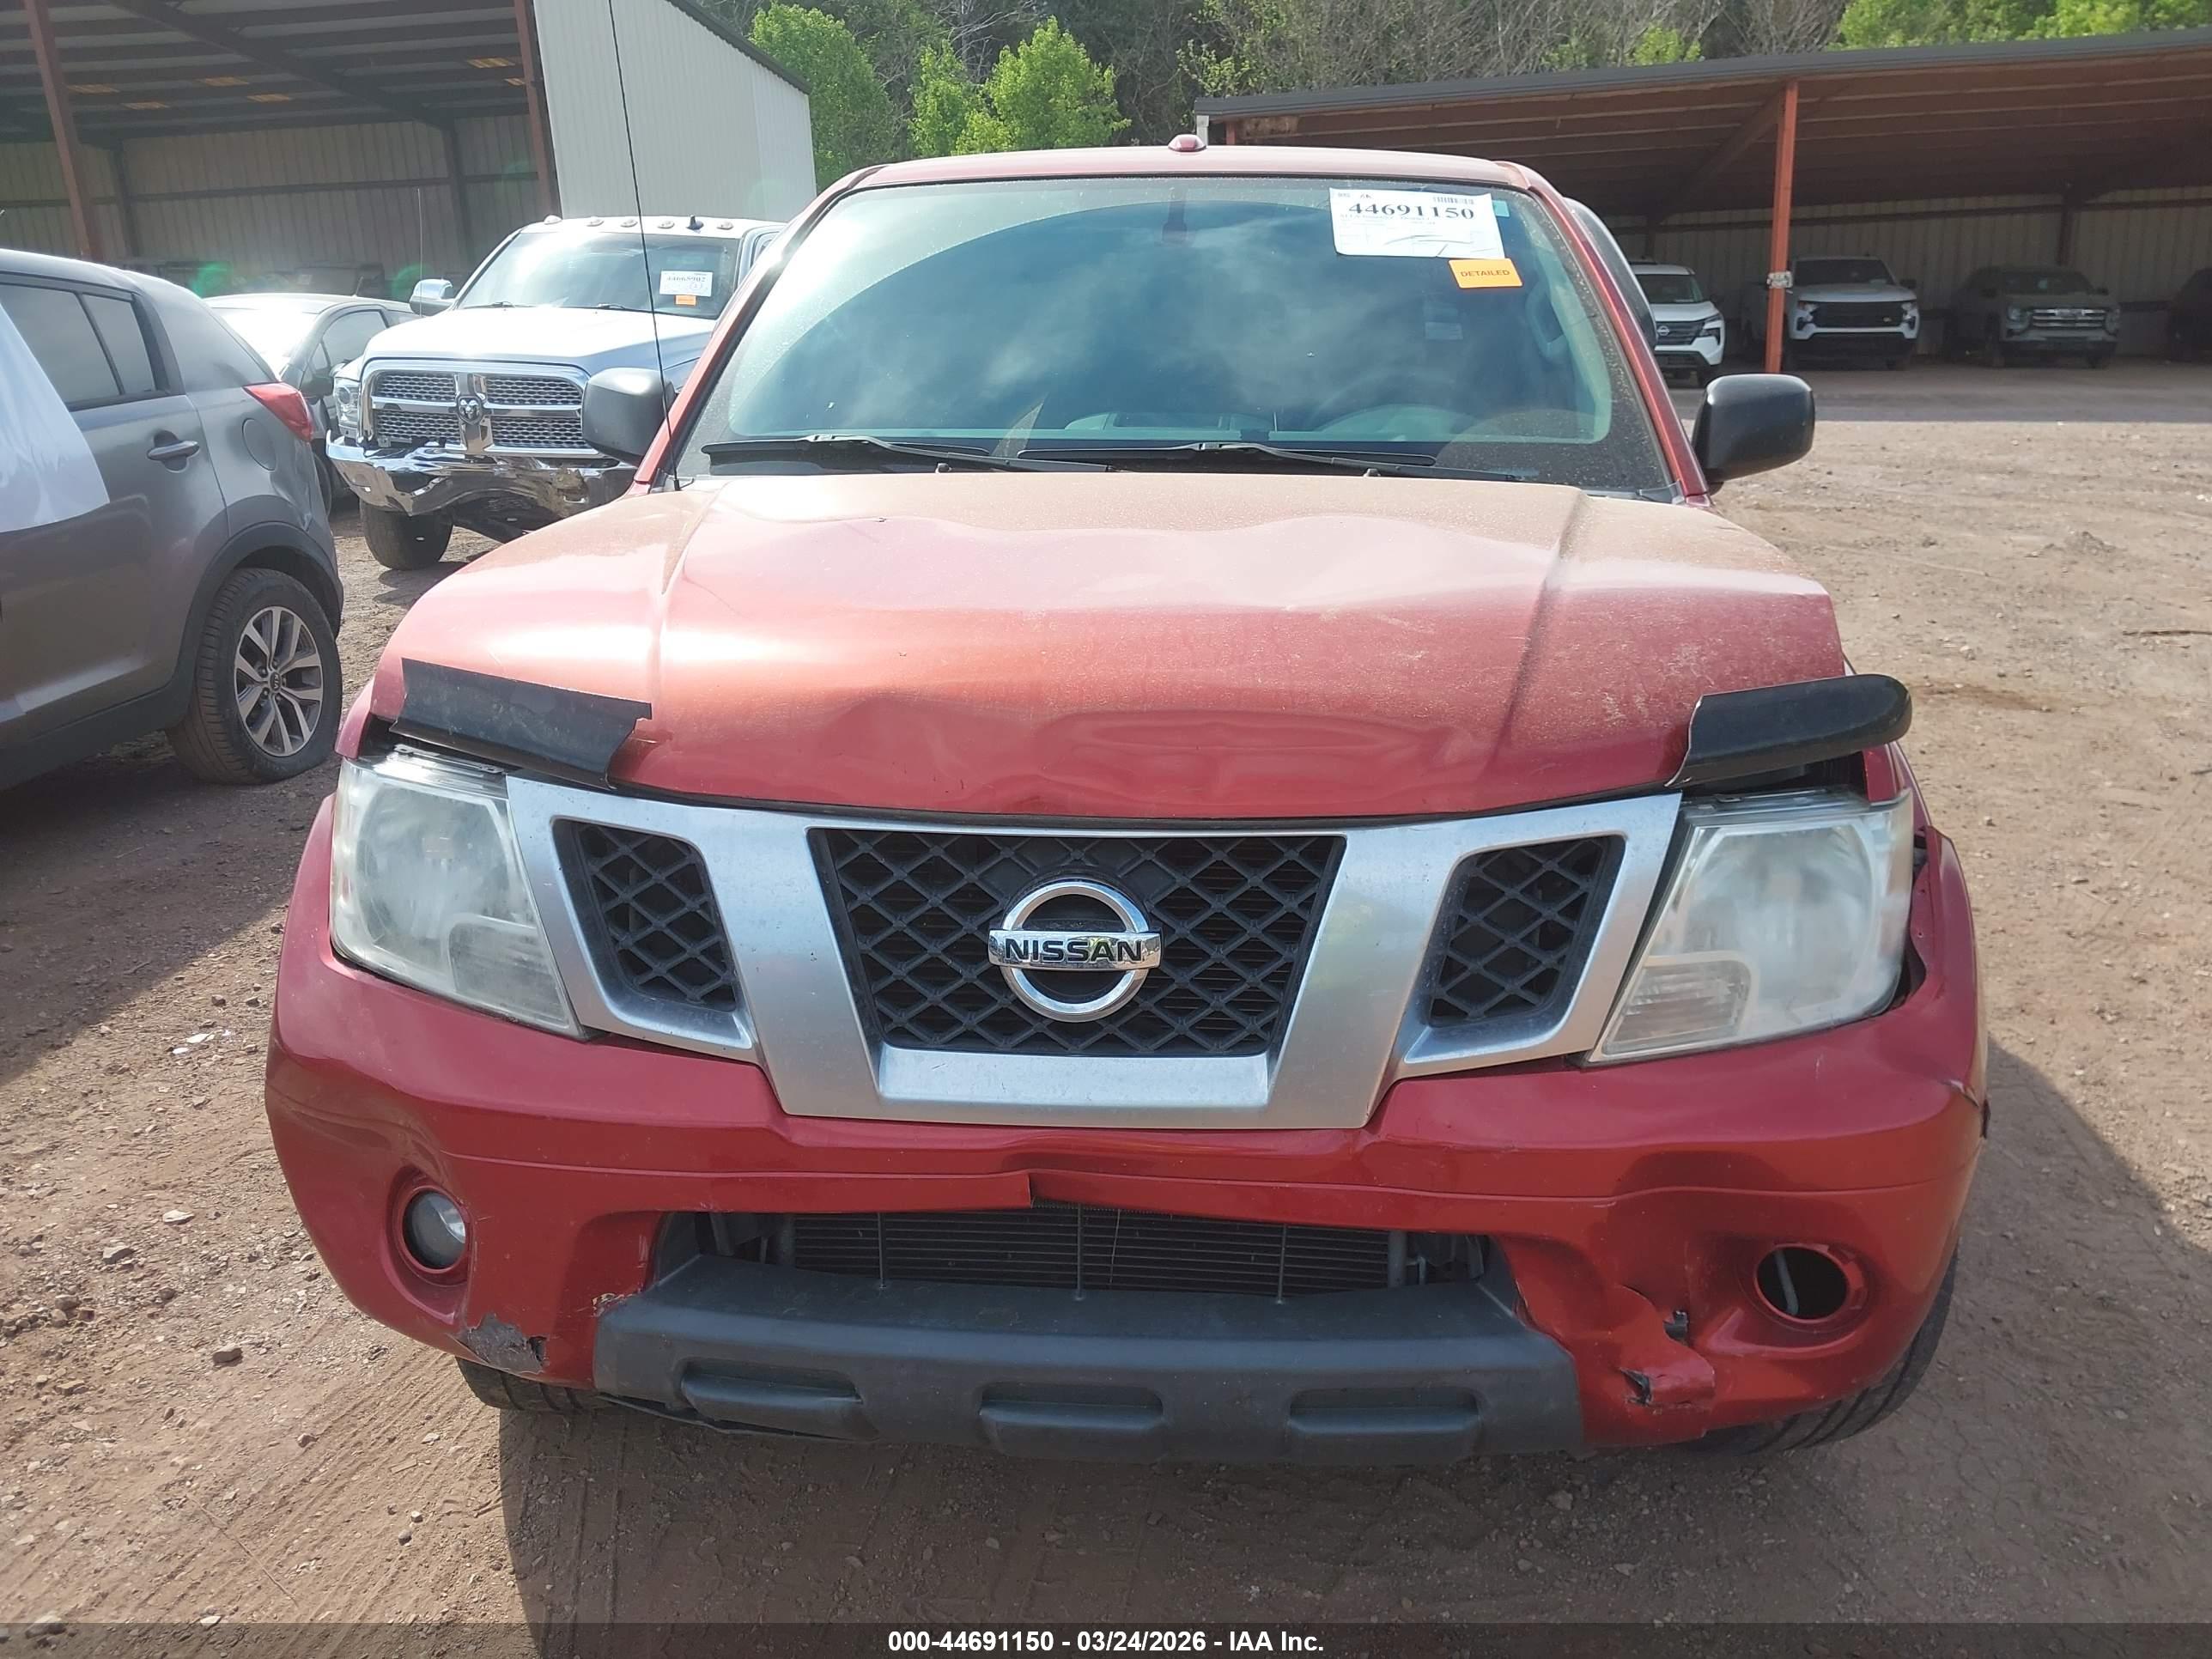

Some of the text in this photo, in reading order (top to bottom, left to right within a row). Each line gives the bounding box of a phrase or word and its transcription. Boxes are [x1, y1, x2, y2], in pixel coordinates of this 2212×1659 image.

[1348, 203, 1474, 220] 44691150
[1461, 269, 1510, 277] DETAILED
[1004, 938, 1143, 963] NISSAN
